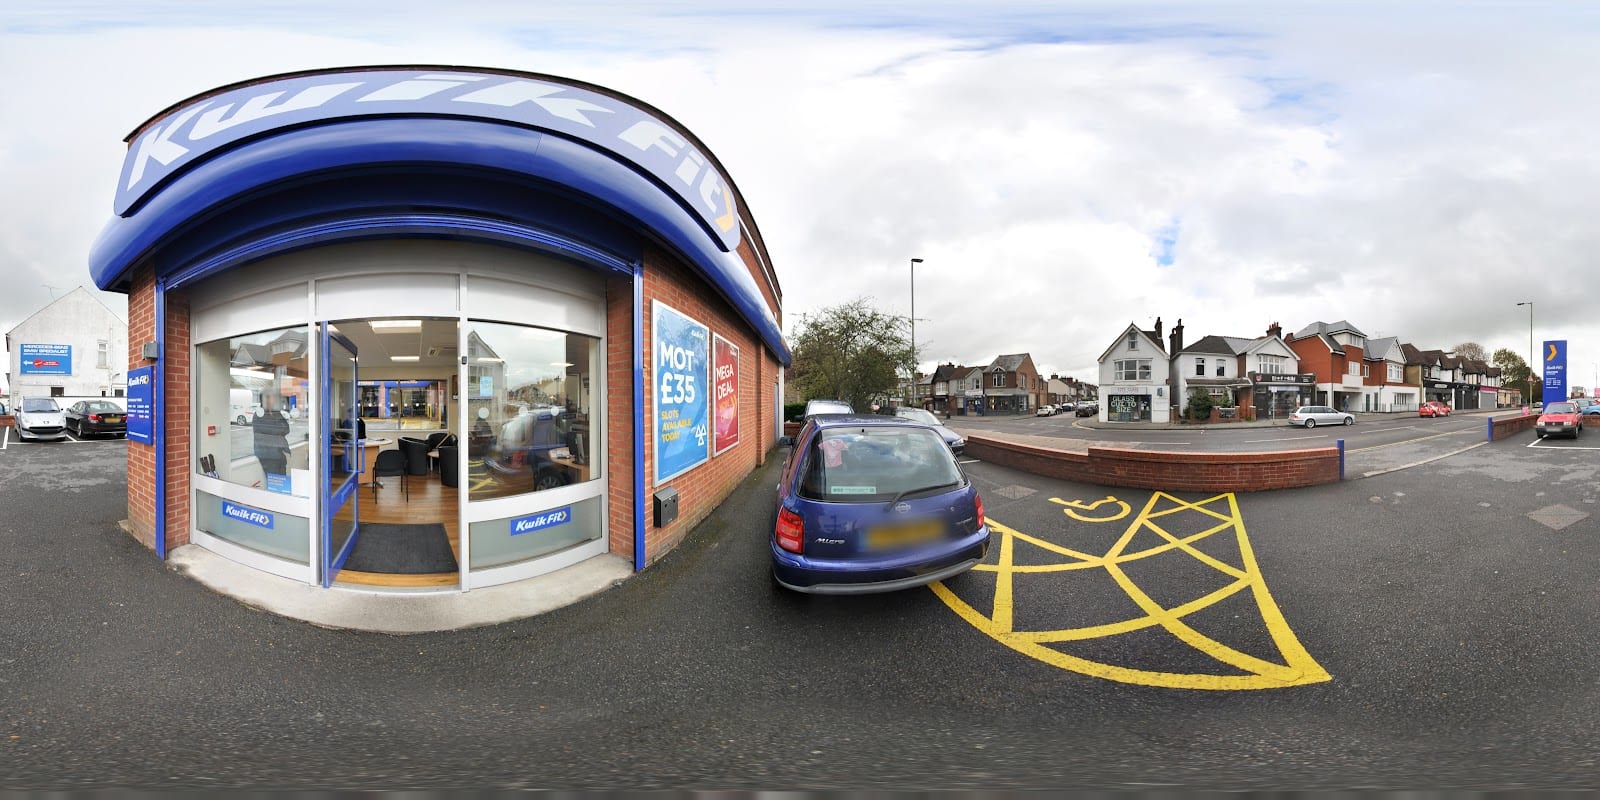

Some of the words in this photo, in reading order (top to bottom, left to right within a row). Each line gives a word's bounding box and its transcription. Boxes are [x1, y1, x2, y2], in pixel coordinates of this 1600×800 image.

[127, 74, 615, 192] Kwik
[617, 120, 726, 213] Fit
[661, 342, 694, 371] MOT
[716, 364, 734, 383] MEGA
[661, 373, 695, 404] £35
[718, 380, 734, 400] DEAL
[661, 409, 679, 420] SLOTS
[662, 418, 691, 431] AVAILABLE
[662, 431, 680, 443] TODAY
[226, 505, 250, 519] Kwik
[250, 512, 264, 524] Fit
[515, 516, 547, 531] Kwik
[547, 511, 562, 524] Fit
